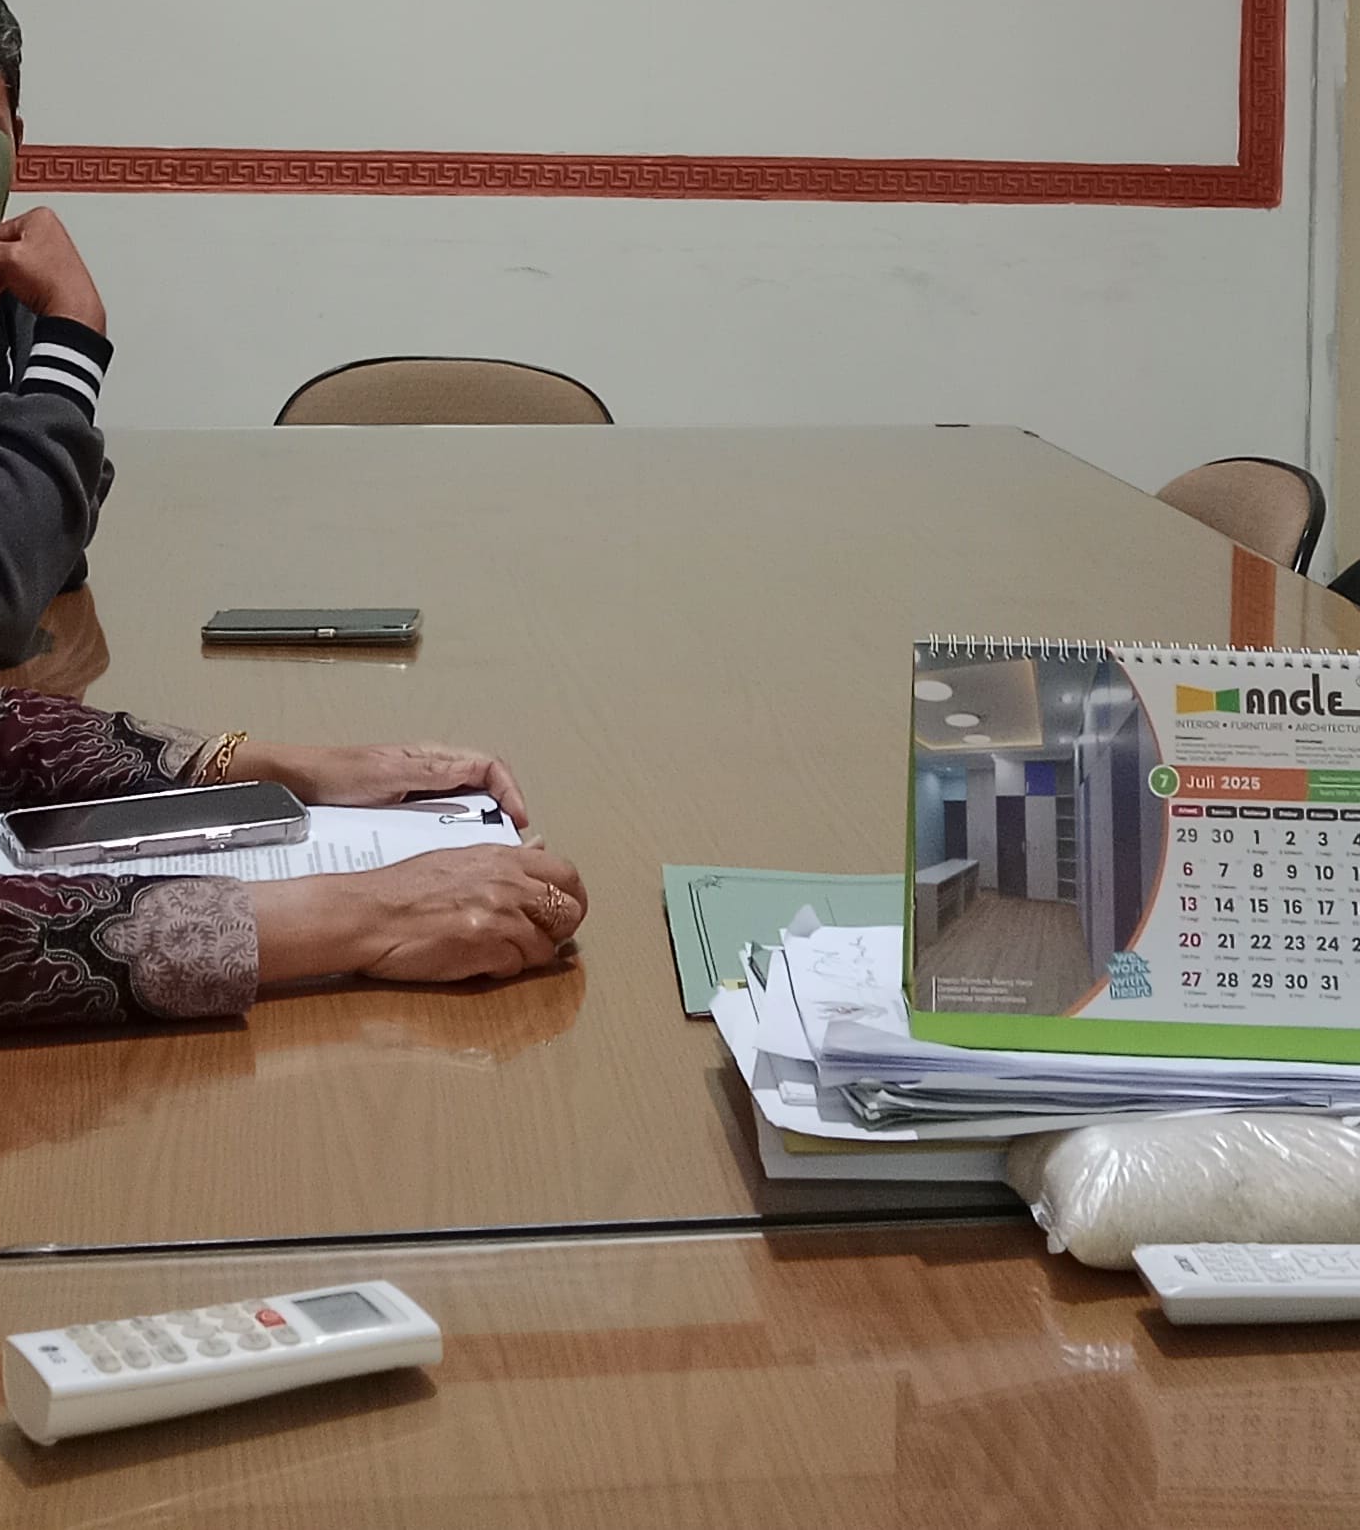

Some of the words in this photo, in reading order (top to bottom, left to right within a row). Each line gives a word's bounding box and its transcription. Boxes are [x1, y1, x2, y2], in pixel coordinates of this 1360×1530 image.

[1175, 720, 1221, 730] INTERIOR
[1231, 721, 1283, 732] FURNITURE
[1159, 775, 1168, 788] 7
[1186, 775, 1215, 790] Juli
[1221, 776, 1261, 790] 2025
[1177, 829, 1197, 843] 29
[1213, 829, 1233, 843] 30
[1254, 830, 1260, 845] 1
[1286, 831, 1296, 845] 2
[1319, 832, 1328, 846] 3
[1184, 862, 1193, 876] 6
[1219, 863, 1228, 877] 7
[1254, 864, 1263, 878] 8
[1287, 865, 1297, 879] 9
[1315, 866, 1334, 880] 10
[1181, 897, 1197, 911] 13
[1216, 898, 1234, 912] 14
[1250, 899, 1269, 913] 15
[1284, 900, 1302, 914] 16
[1318, 901, 1334, 915] 17
[1179, 933, 1201, 947] 20
[1218, 934, 1235, 948] 21
[1251, 935, 1272, 949] 22
[1285, 936, 1305, 950] 23
[1317, 937, 1339, 951] 24
[1107, 960, 1148, 974] work
[1112, 973, 1144, 987] with
[1182, 972, 1202, 987] 27
[1217, 973, 1238, 987] 28
[1252, 974, 1273, 988] 29
[1286, 974, 1307, 989] 30
[1322, 976, 1339, 990] 31
[1111, 983, 1151, 998] heart
